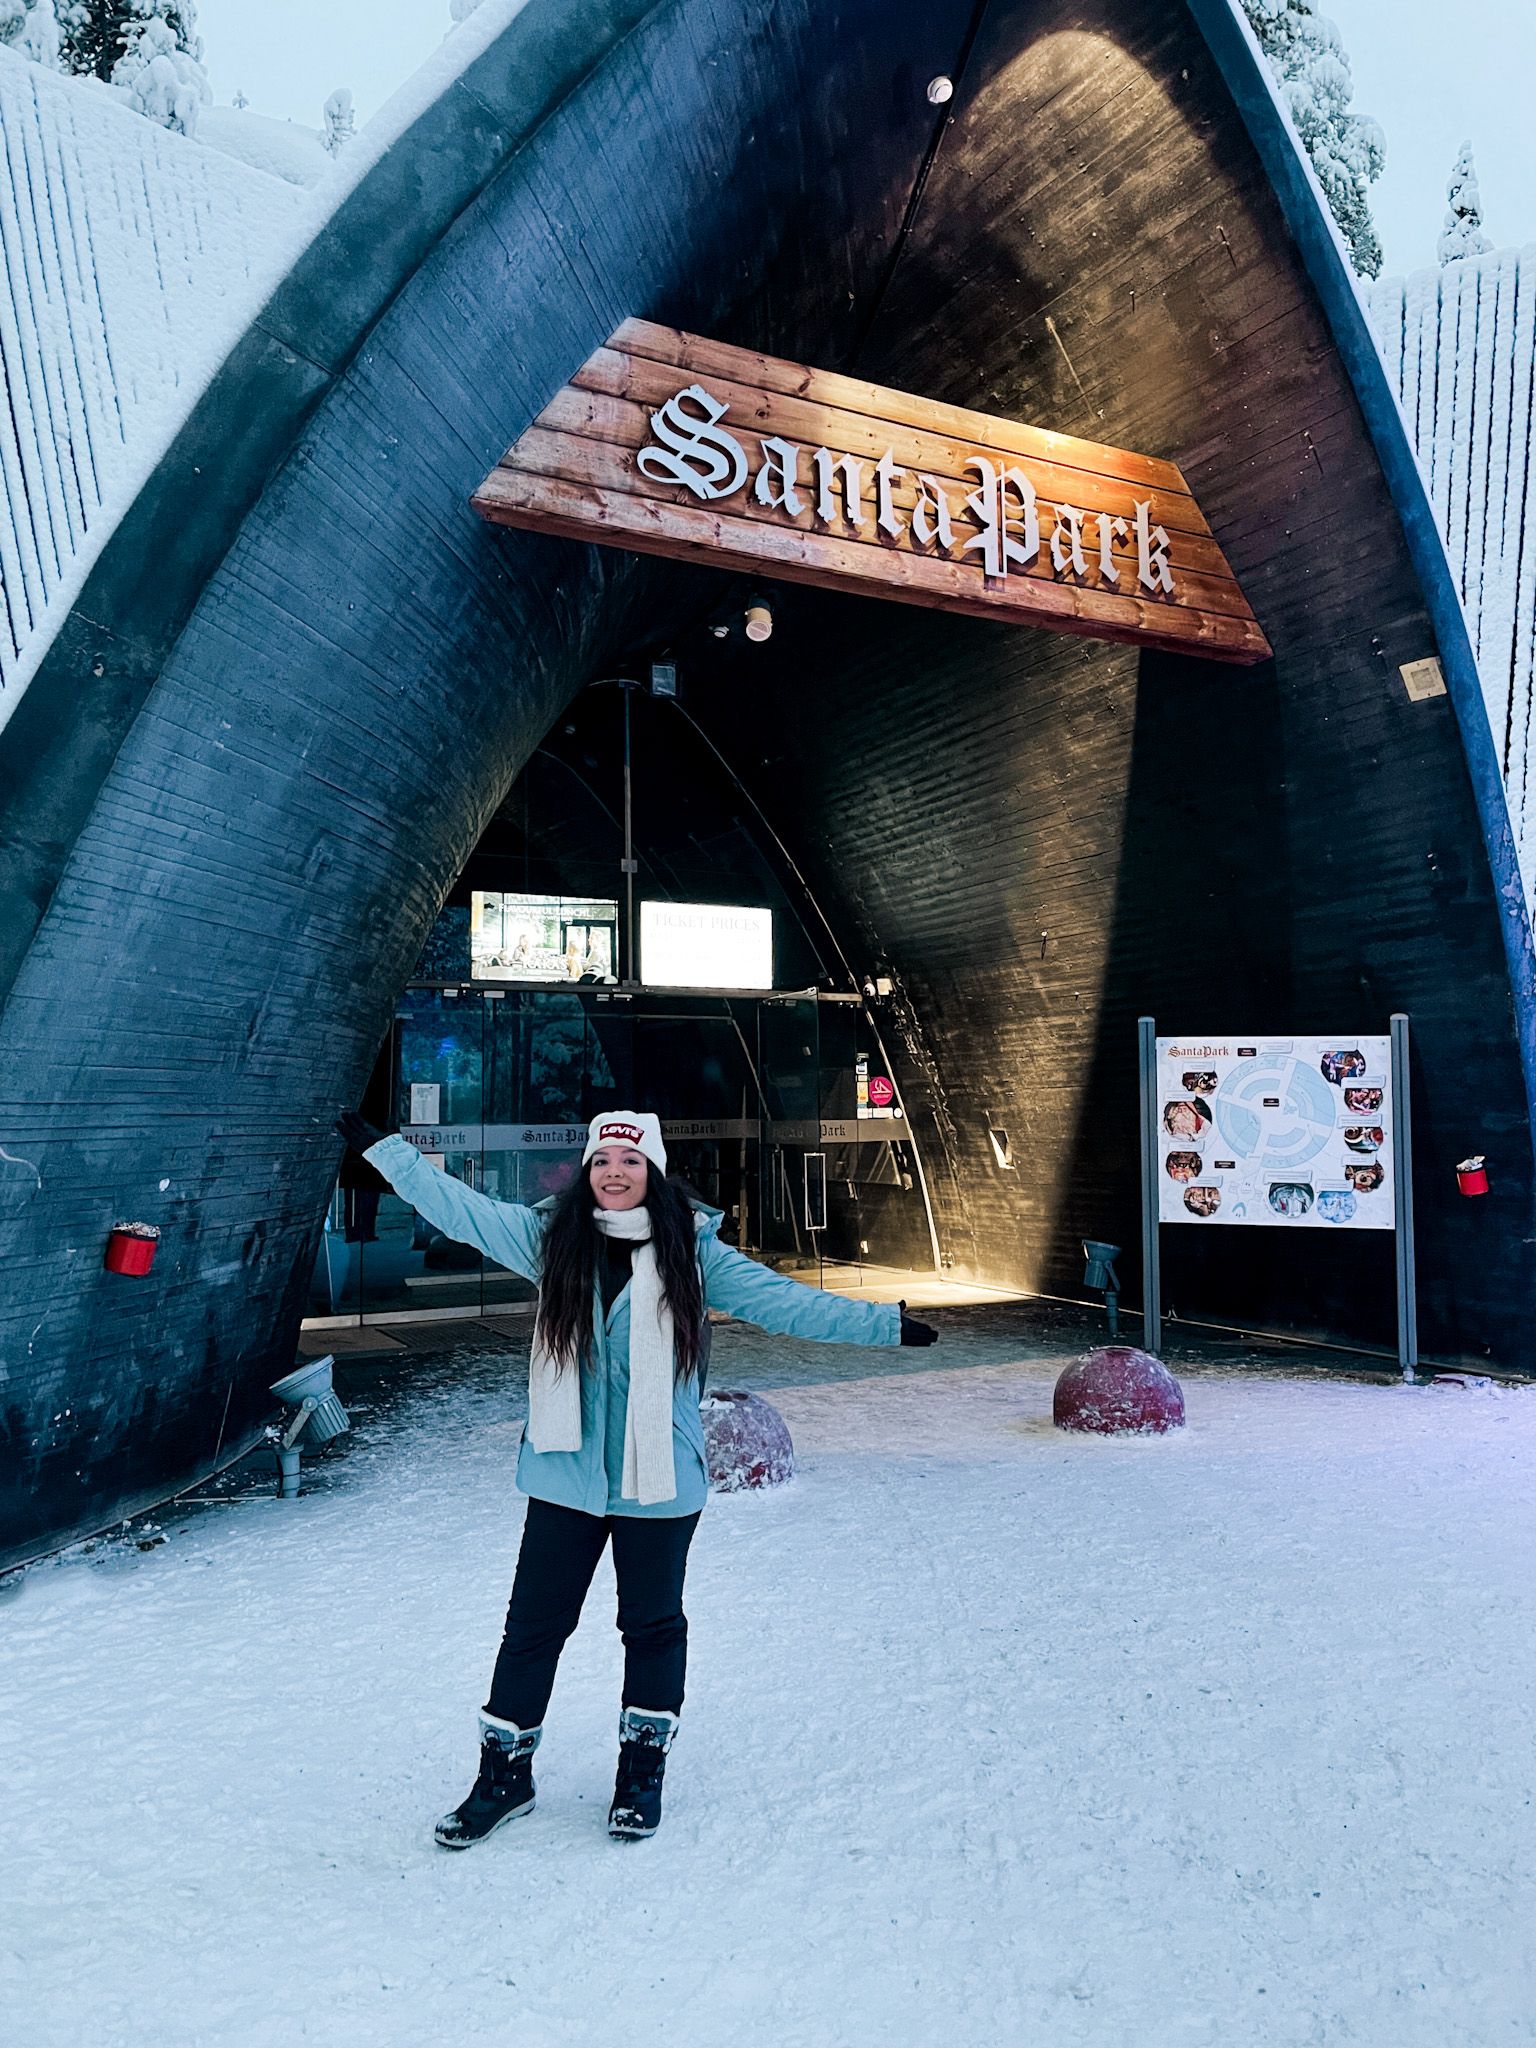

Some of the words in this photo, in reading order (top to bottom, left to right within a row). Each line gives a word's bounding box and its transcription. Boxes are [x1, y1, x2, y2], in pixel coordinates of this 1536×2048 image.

[637, 383, 1177, 595] SantaPark
[652, 912, 706, 928] TICKET
[711, 916, 760, 931] PRICES
[1168, 1046, 1229, 1057] SantaPark
[521, 1128, 590, 1144] SantaPar
[664, 1122, 716, 1136] antaPark
[403, 1130, 466, 1148] ntaPark
